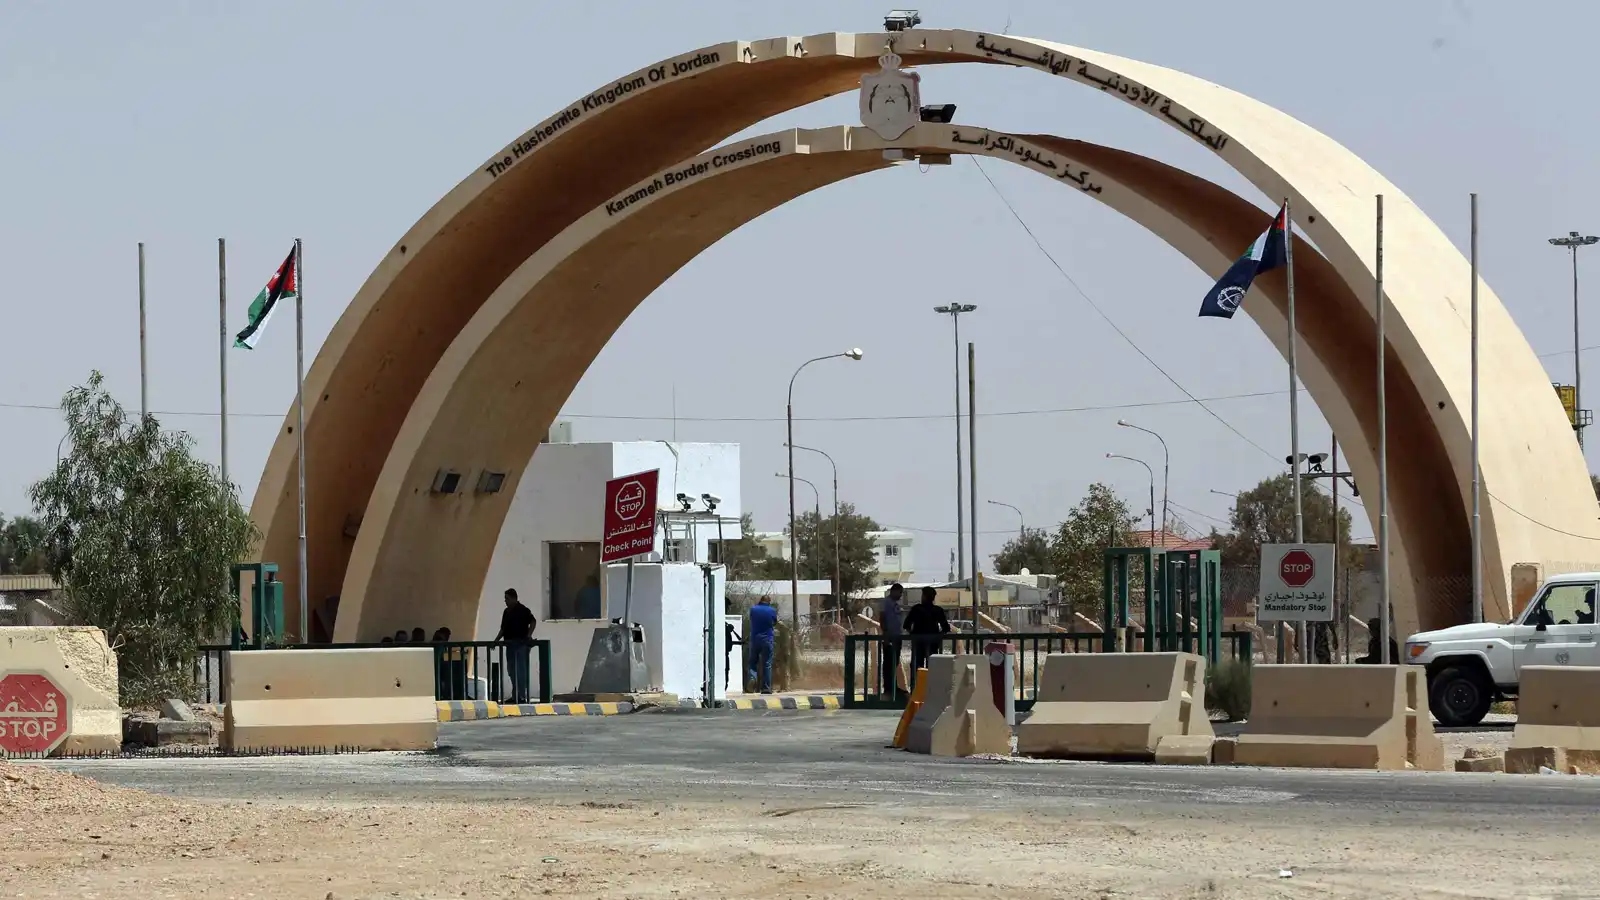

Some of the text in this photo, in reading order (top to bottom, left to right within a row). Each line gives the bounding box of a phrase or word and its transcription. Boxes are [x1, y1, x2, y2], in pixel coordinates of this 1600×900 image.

[975, 34, 1071, 75] الهاشمية
[485, 50, 720, 179] The Hashemite Kingdom Of Jordan
[951, 130, 1102, 194] مركز حدود الكرامة
[605, 140, 781, 216] Karameh Border Crossiong
[619, 486, 642, 503] قف
[620, 501, 641, 514] STOP
[636, 517, 652, 530] قف
[604, 536, 652, 554] Check Point
[1283, 564, 1311, 573] STOP
[1264, 603, 1326, 612] Mandatory Stop
[0, 720, 57, 738] STOP
